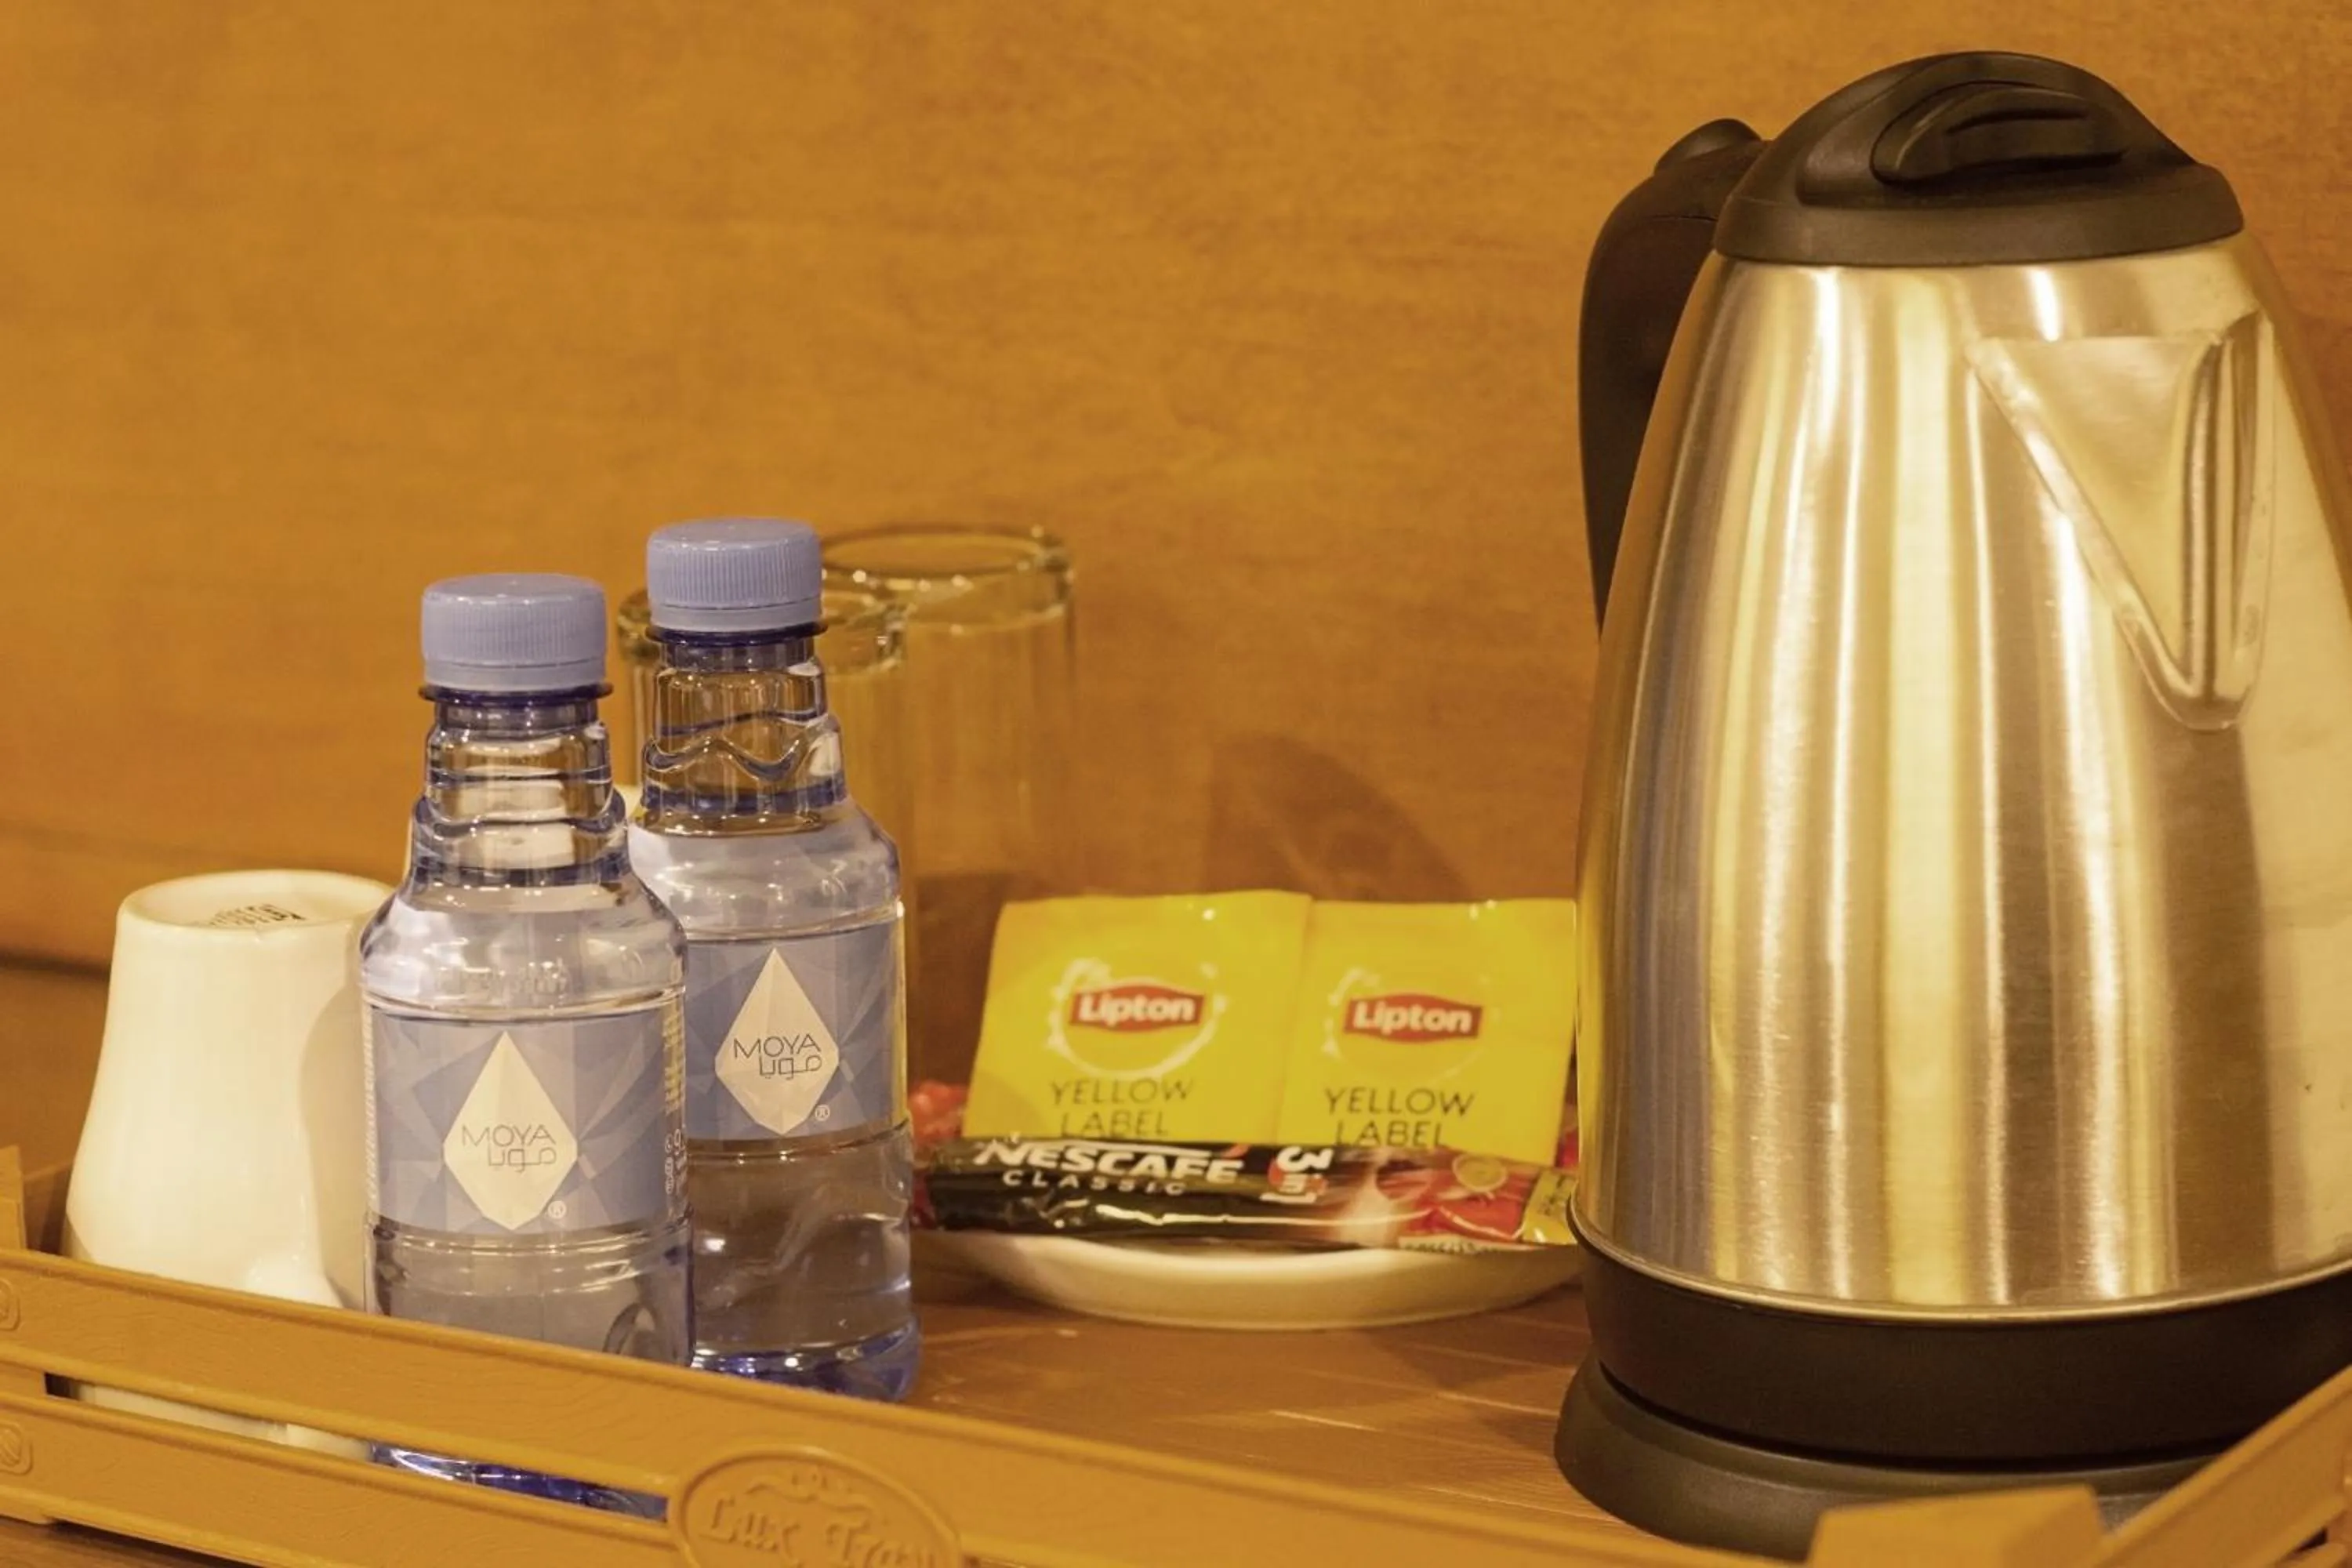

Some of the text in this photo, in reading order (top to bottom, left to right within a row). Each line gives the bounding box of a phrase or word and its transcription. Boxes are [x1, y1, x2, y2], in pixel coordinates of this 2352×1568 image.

[1078, 993, 1196, 1027] Lipton
[1352, 1000, 1474, 1035] Lipton
[733, 1033, 822, 1058] MOYA
[1049, 1077, 1196, 1105] YELLOW
[1323, 1086, 1476, 1117] YELLOW
[460, 1123, 557, 1148] MOYA
[1060, 1109, 1170, 1139] LABEL
[1334, 1119, 1447, 1149] LABEL
[1002, 1170, 1188, 1196] CLASSIC
